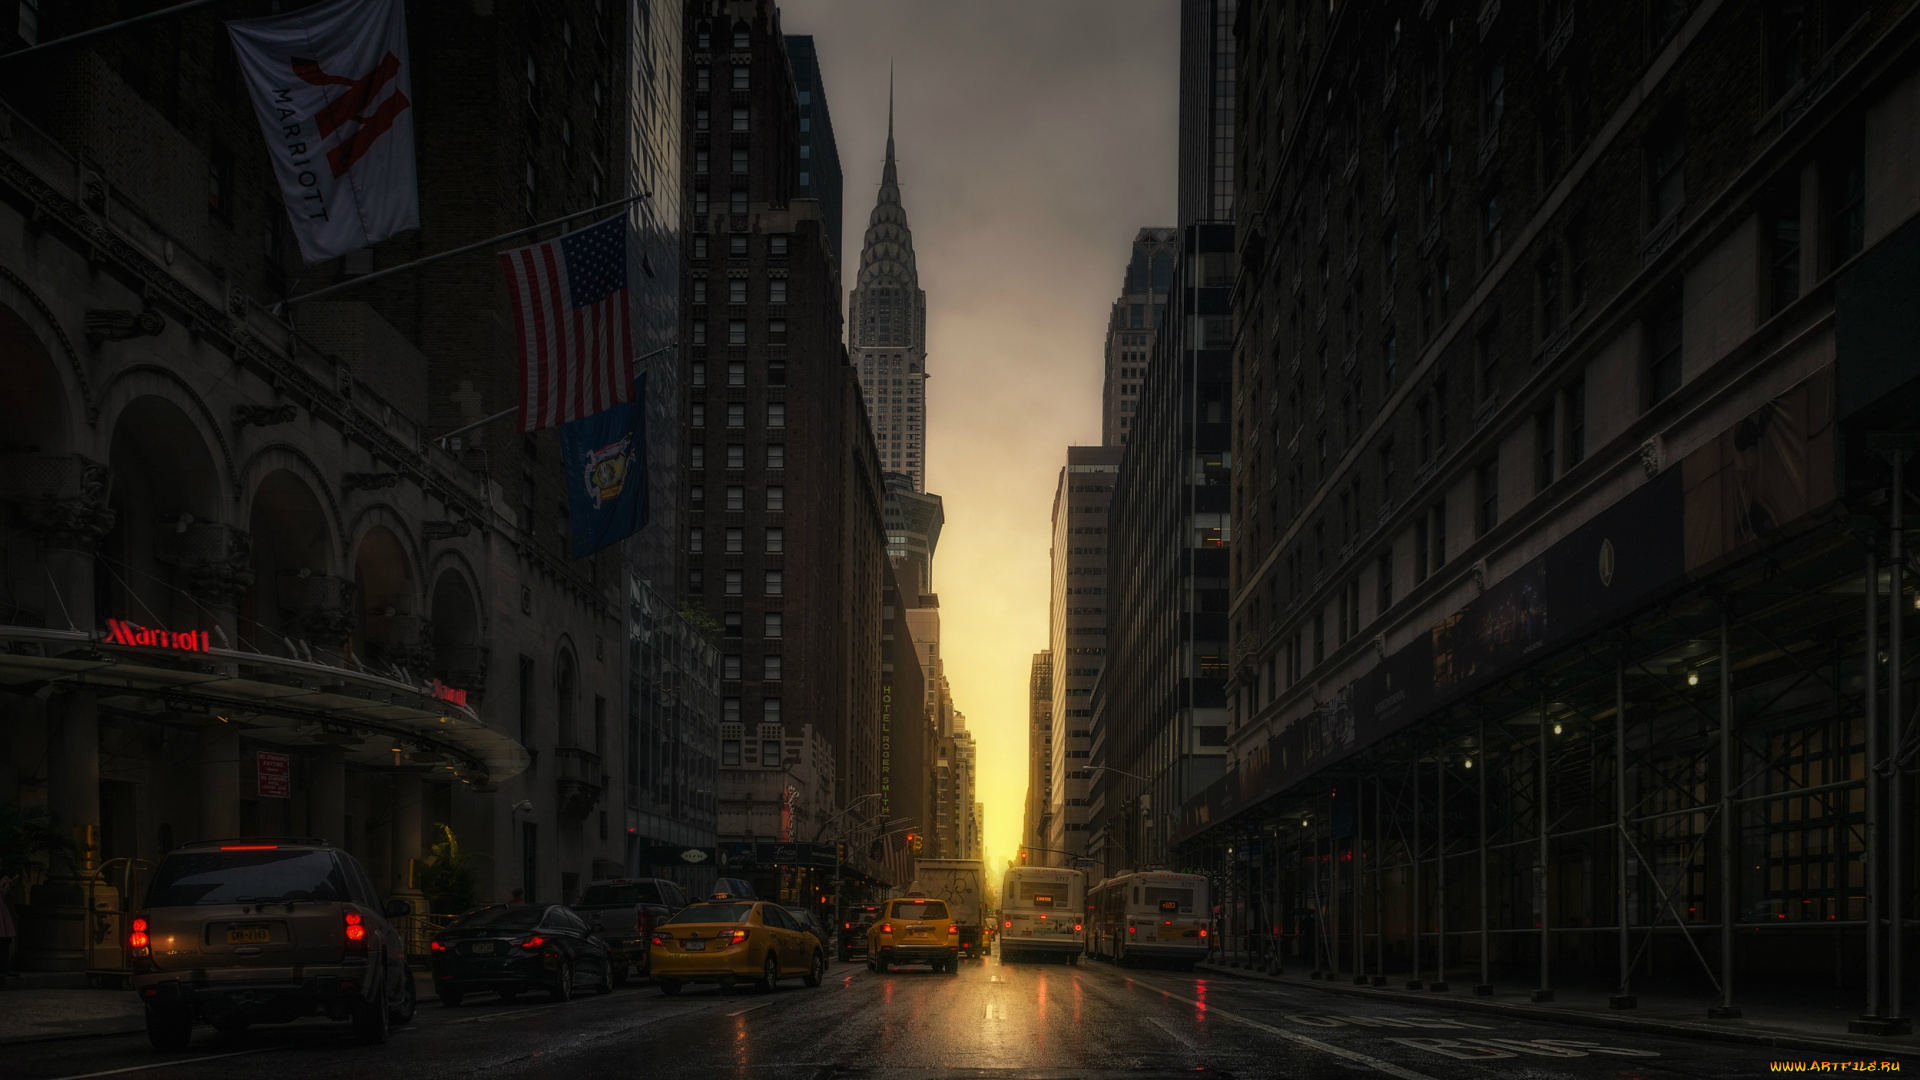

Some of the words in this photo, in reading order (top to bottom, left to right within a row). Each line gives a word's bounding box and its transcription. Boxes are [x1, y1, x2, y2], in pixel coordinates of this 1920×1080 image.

[272, 88, 329, 222] MARRIOTT
[102, 618, 209, 653] Marriott
[882, 686, 891, 732] HOTEL
[882, 735, 891, 773] ROGER
[882, 777, 891, 814] SMITH
[1382, 1037, 1662, 1060] BUS
